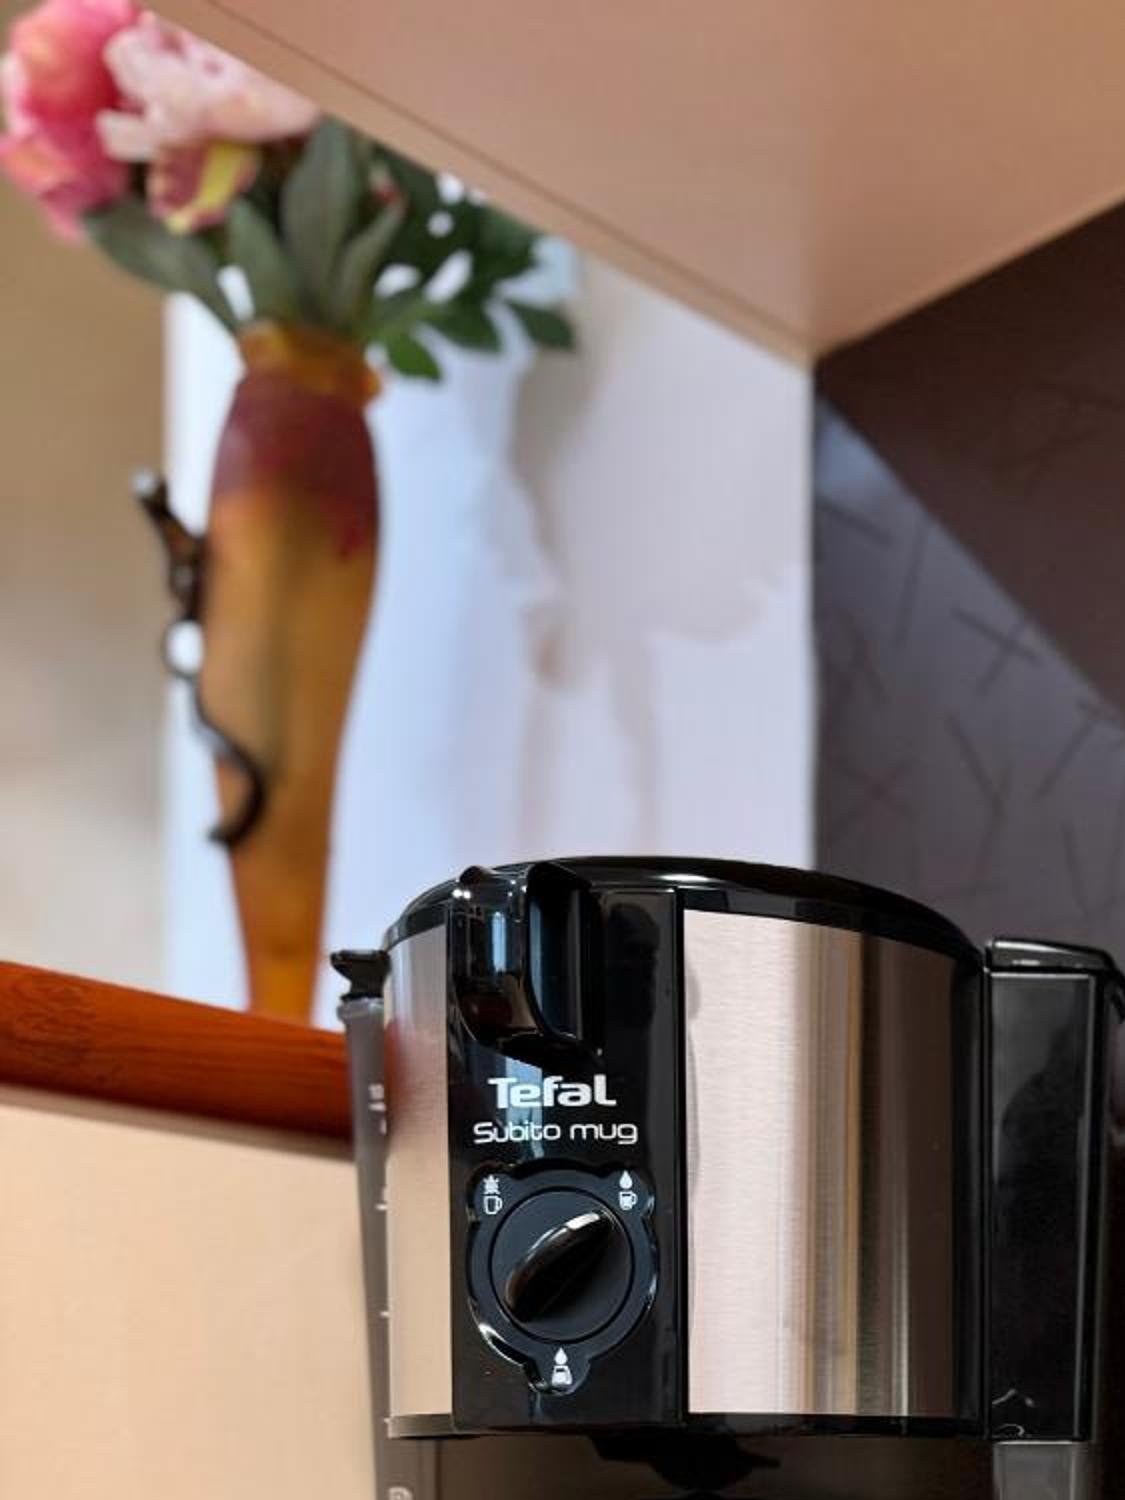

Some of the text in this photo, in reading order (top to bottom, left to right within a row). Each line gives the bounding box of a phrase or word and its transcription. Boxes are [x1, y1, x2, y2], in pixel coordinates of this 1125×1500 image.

[487, 1074, 617, 1109] Tefal
[473, 1120, 638, 1145] Subito mug
